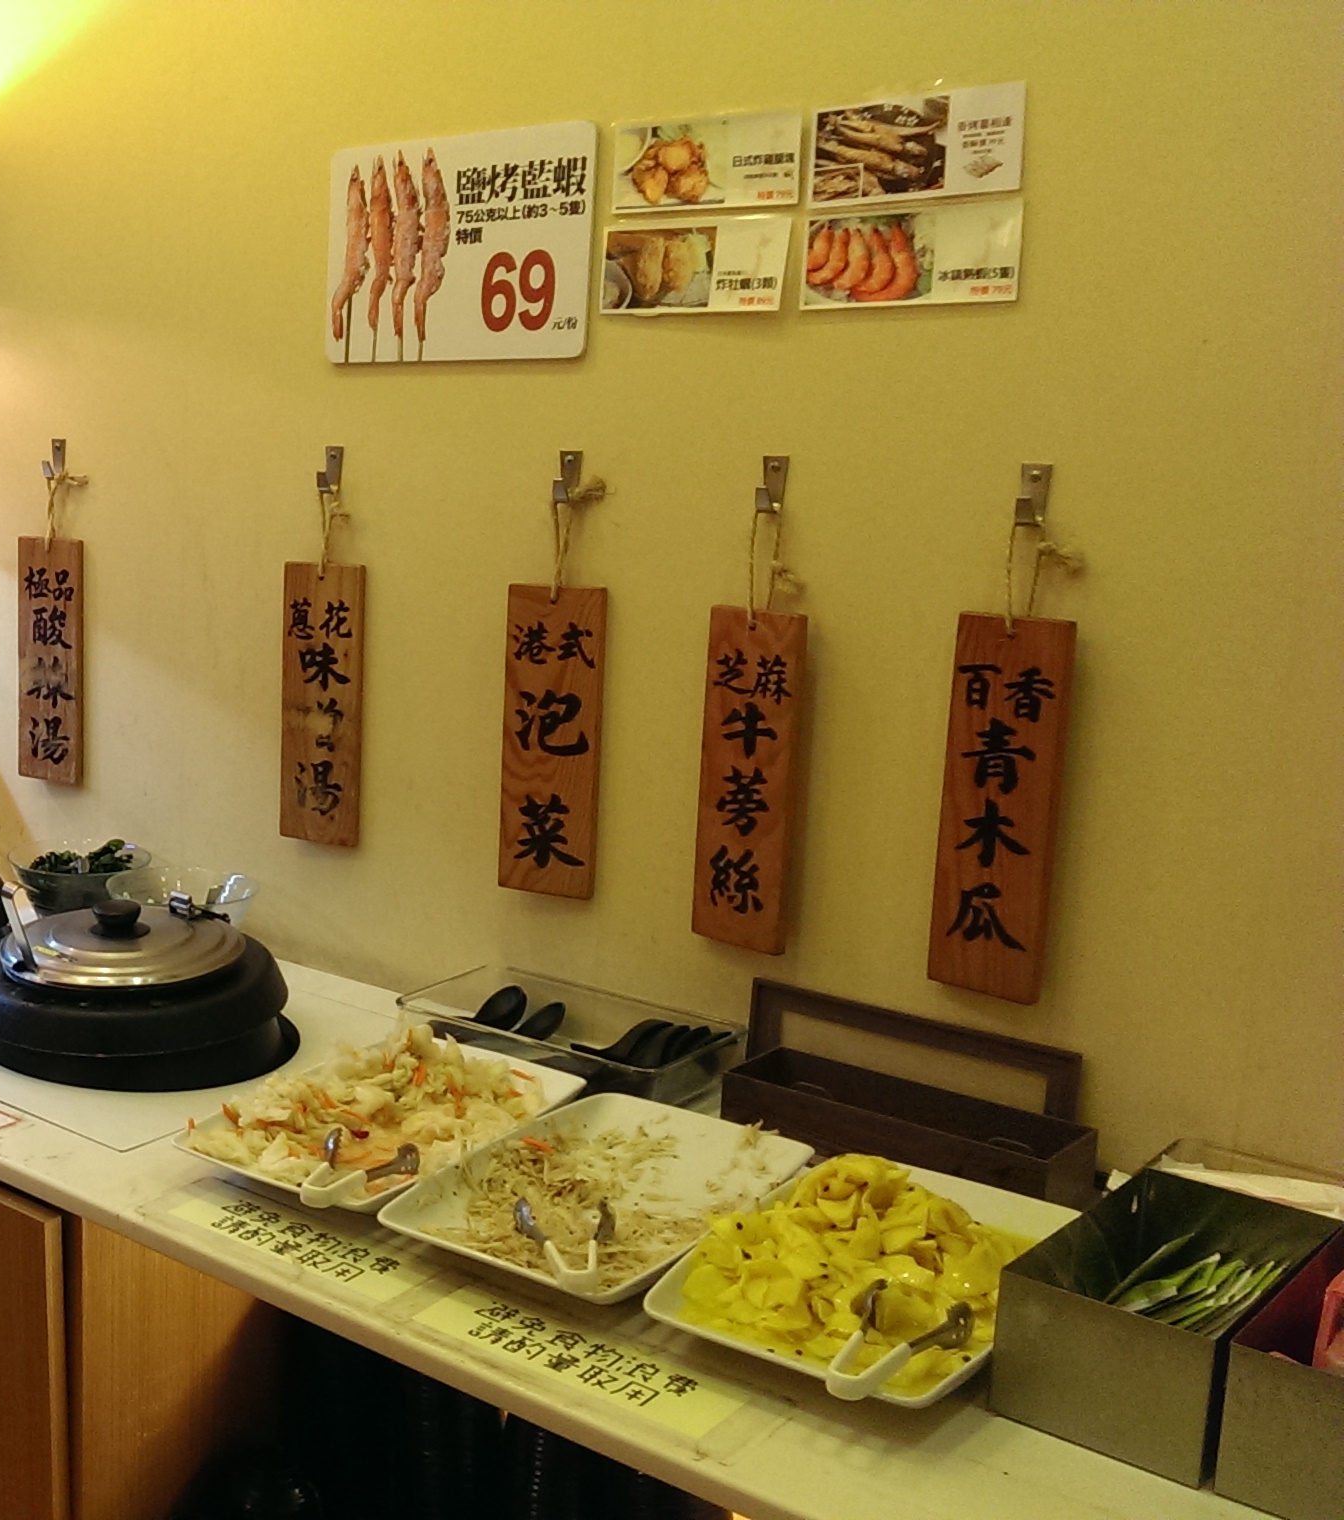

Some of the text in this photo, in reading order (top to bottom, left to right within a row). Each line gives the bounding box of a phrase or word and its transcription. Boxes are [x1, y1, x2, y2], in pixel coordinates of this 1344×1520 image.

[455, 156, 587, 206] 鹽烤藍蝦
[455, 227, 483, 245] 特價
[480, 249, 556, 333] 69
[24, 566, 75, 601] 極品
[512, 621, 596, 669] 港式
[958, 663, 1057, 723] 百香
[514, 690, 590, 869] 泡菜
[708, 702, 778, 915] 牛蒡絲
[946, 718, 1037, 953] 青木瓜
[210, 1215, 366, 1283] 請酌量取用
[221, 1199, 401, 1275] 避免食物浪費
[467, 1321, 661, 1408] 請酌量取用
[474, 1301, 699, 1398] 避免食物浪費
